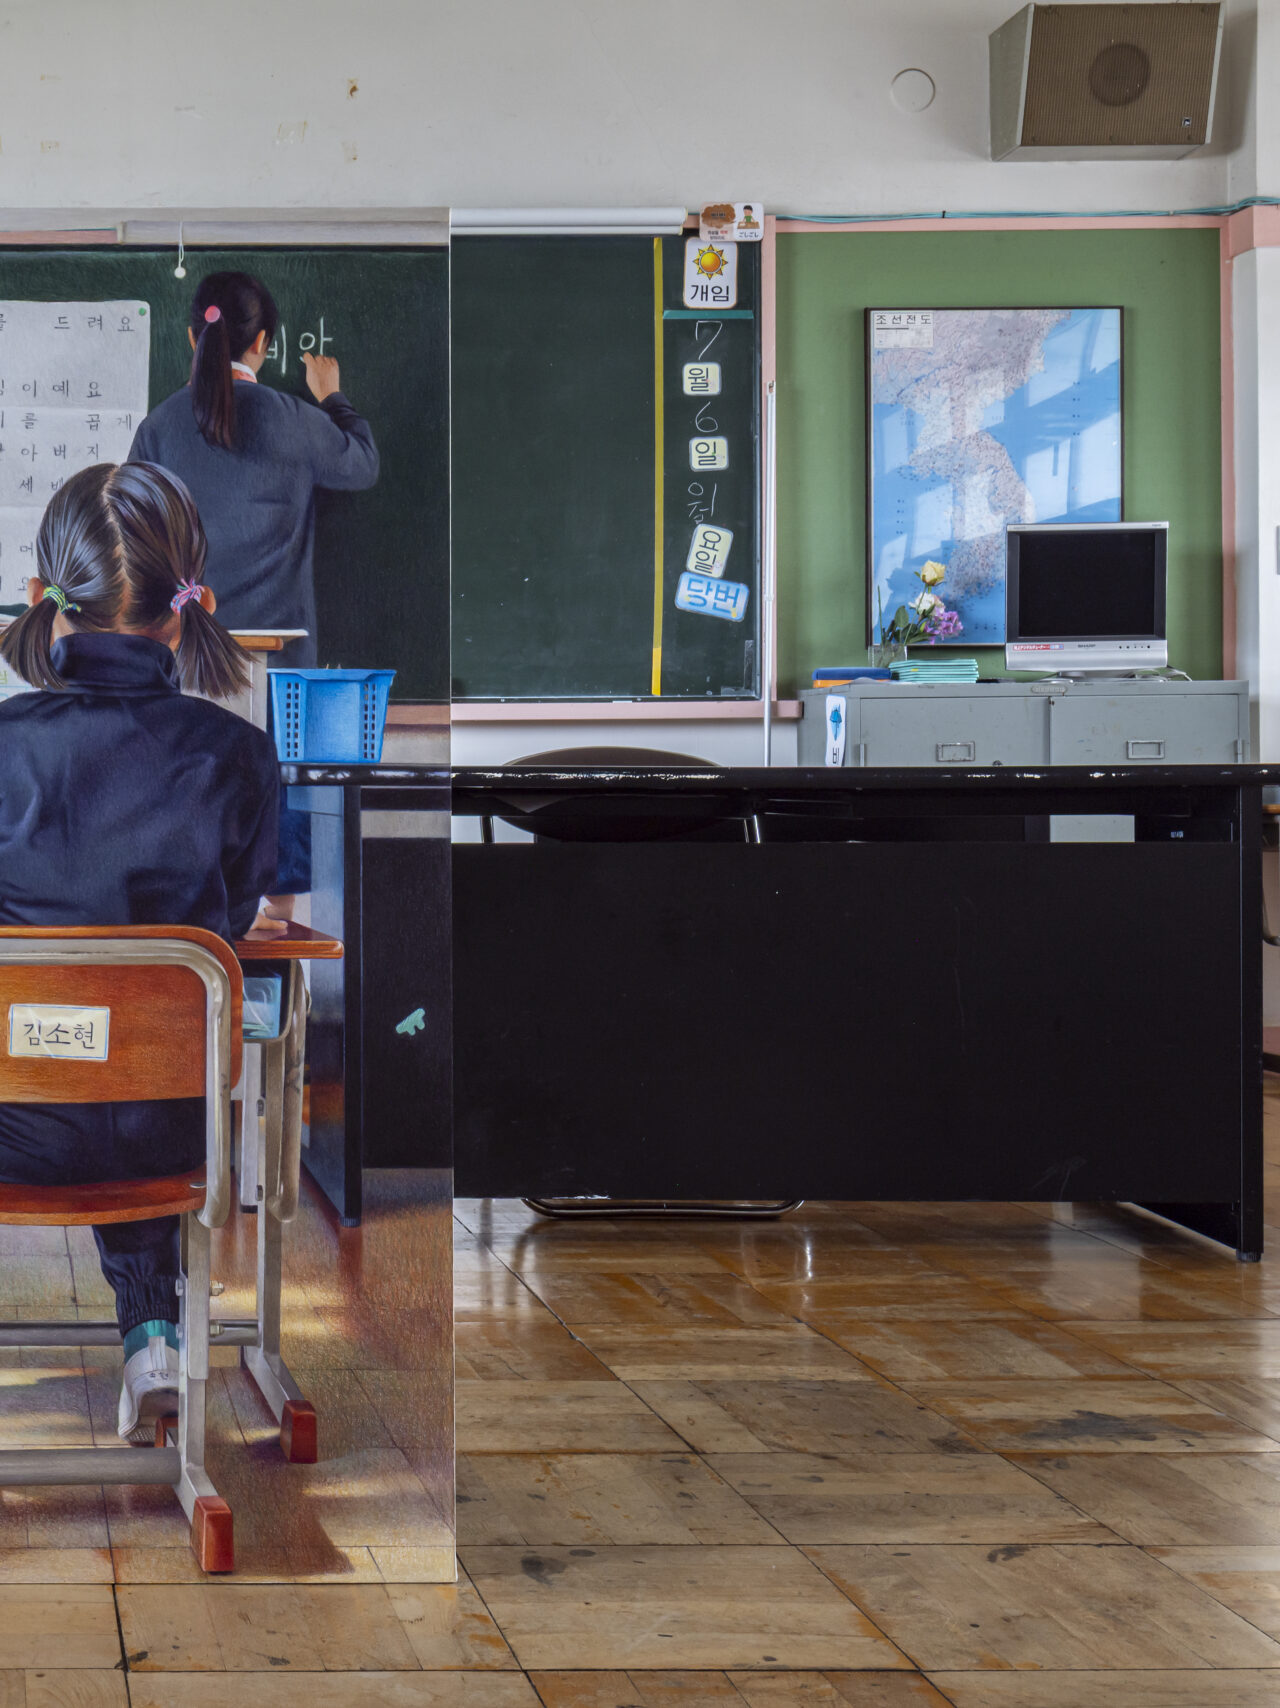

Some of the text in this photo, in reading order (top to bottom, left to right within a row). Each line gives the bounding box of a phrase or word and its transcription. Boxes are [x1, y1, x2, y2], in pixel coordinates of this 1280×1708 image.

[690, 285, 729, 302] 개임
[54, 315, 135, 331] 드려요
[687, 577, 740, 614] 당번
[23, 1020, 96, 1050] 김소현
